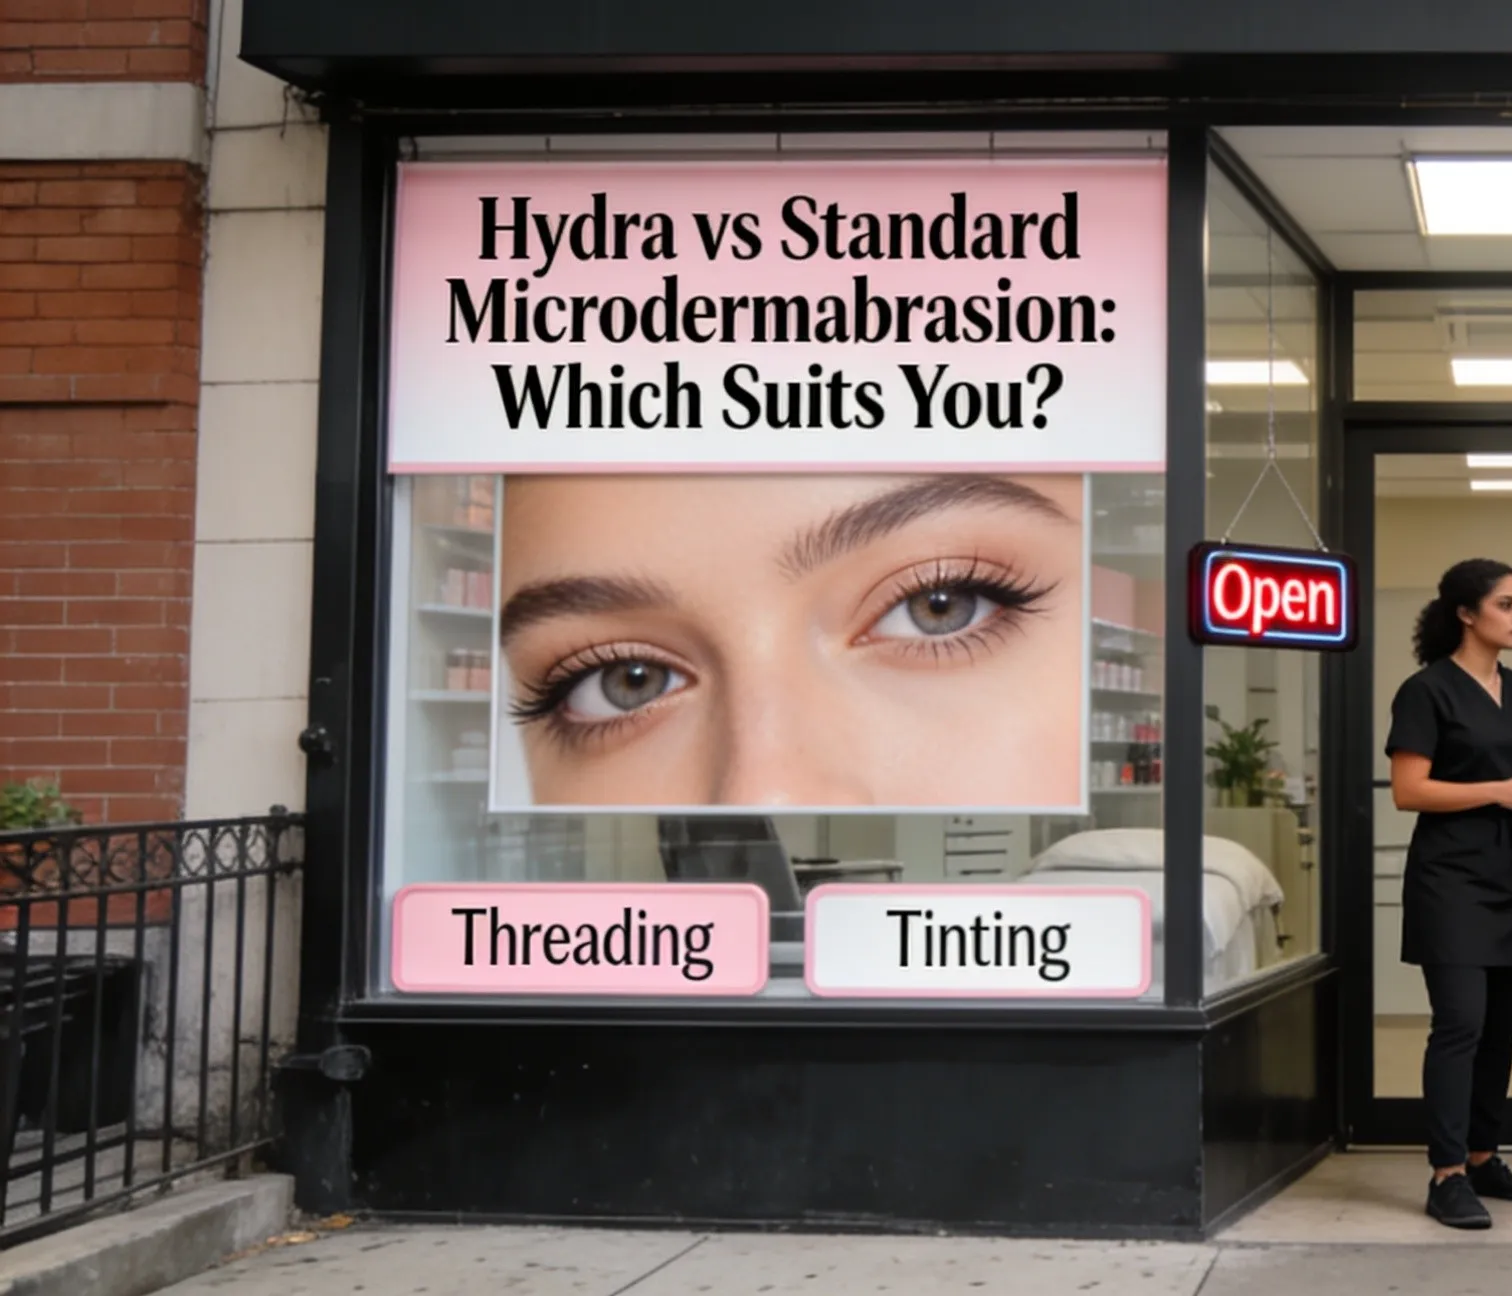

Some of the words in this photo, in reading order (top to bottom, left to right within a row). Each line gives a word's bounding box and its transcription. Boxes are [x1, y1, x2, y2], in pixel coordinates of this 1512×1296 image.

[479, 192, 678, 276] Hydra
[692, 213, 762, 261] vs
[781, 191, 1081, 260] Standard
[446, 275, 1117, 344] Microdermabrasion:
[491, 361, 702, 430] Which
[722, 362, 885, 430] Suits
[898, 362, 1064, 430] You?
[1212, 562, 1337, 635] Open
[451, 906, 715, 982] Threading
[886, 910, 1071, 982] Tinting
